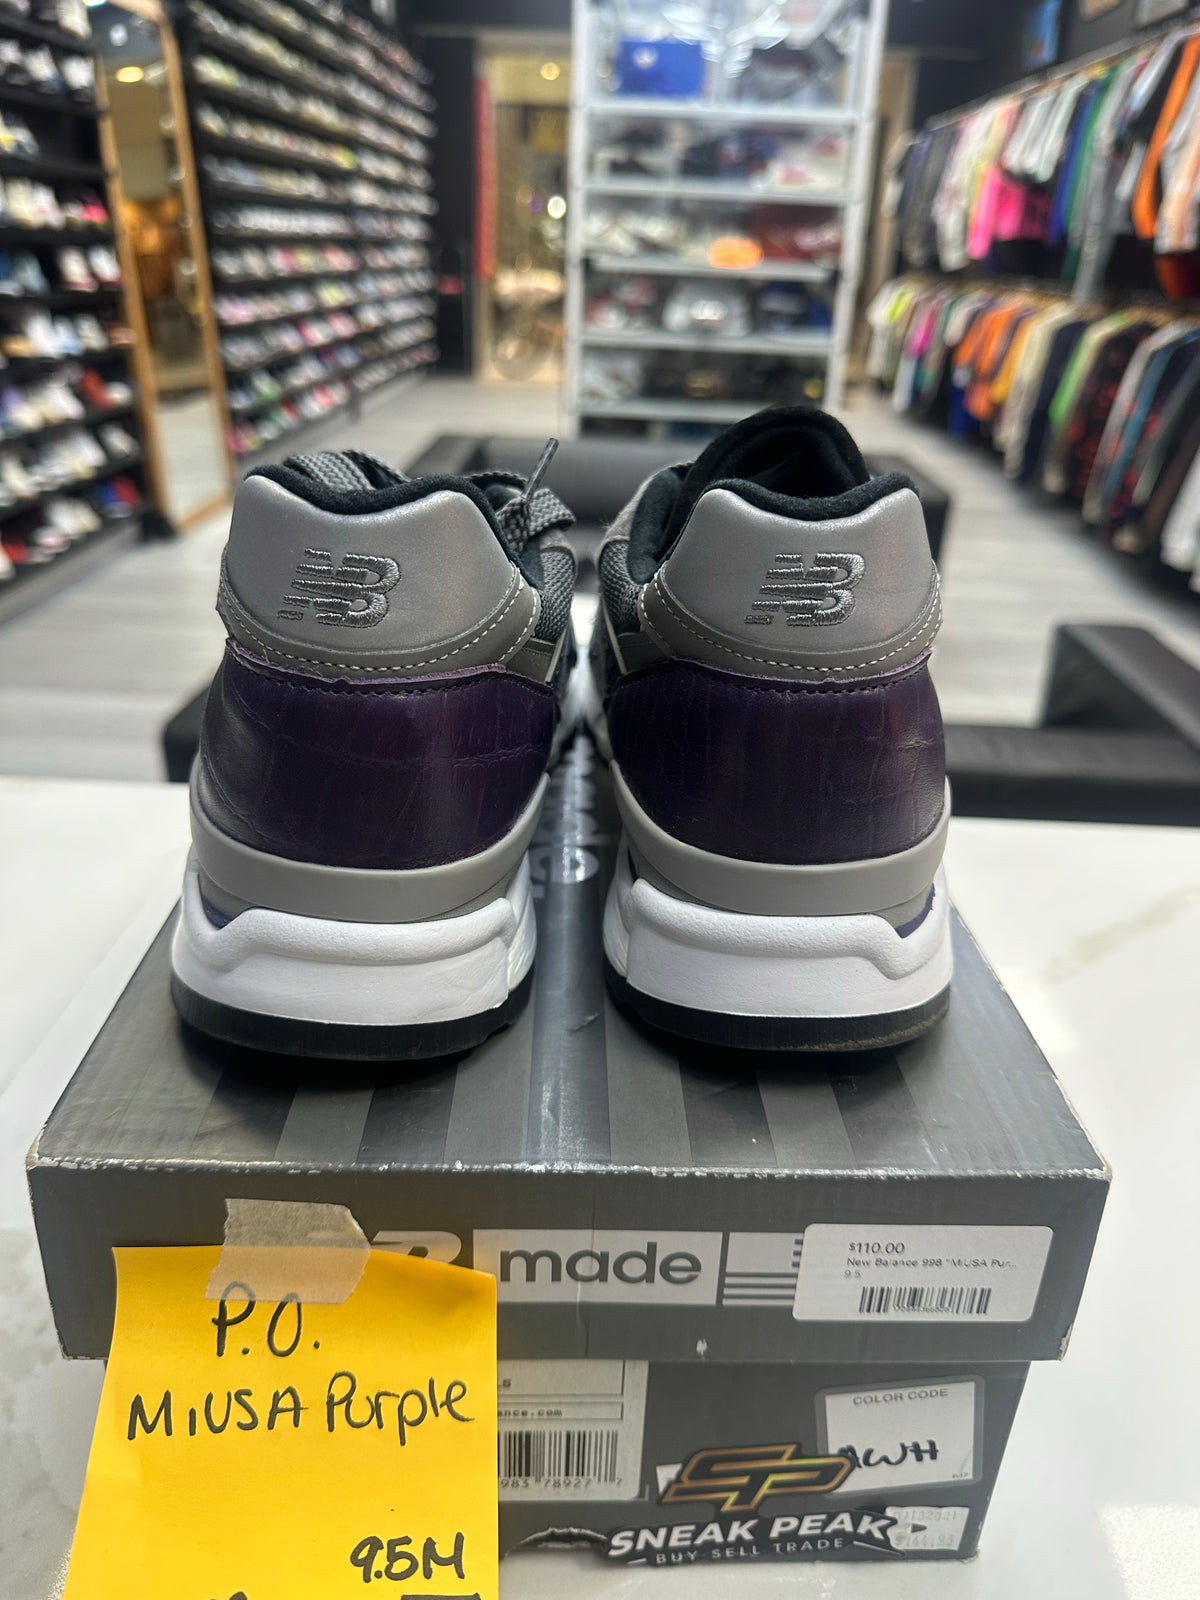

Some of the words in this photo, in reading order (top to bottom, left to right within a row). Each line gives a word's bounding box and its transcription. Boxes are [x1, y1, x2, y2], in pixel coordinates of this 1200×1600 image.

[500, 1241, 702, 1286] made
[847, 1257, 871, 1267] New
[875, 1257, 918, 1268] Balance
[921, 1257, 943, 1268] 998
[849, 1241, 906, 1255] $110.00
[211, 1281, 320, 1358] P.O.
[326, 1370, 475, 1447] Purple
[852, 1391, 904, 1406] COLOR
[907, 1387, 950, 1401] CODE
[608, 1518, 759, 1557] SNEAK
[769, 1512, 896, 1541] PEAK
[656, 1550, 700, 1565] BUY
[711, 1545, 761, 1559] SELL
[774, 1537, 845, 1554] TRADE
[350, 1531, 466, 1584] 9.5M
